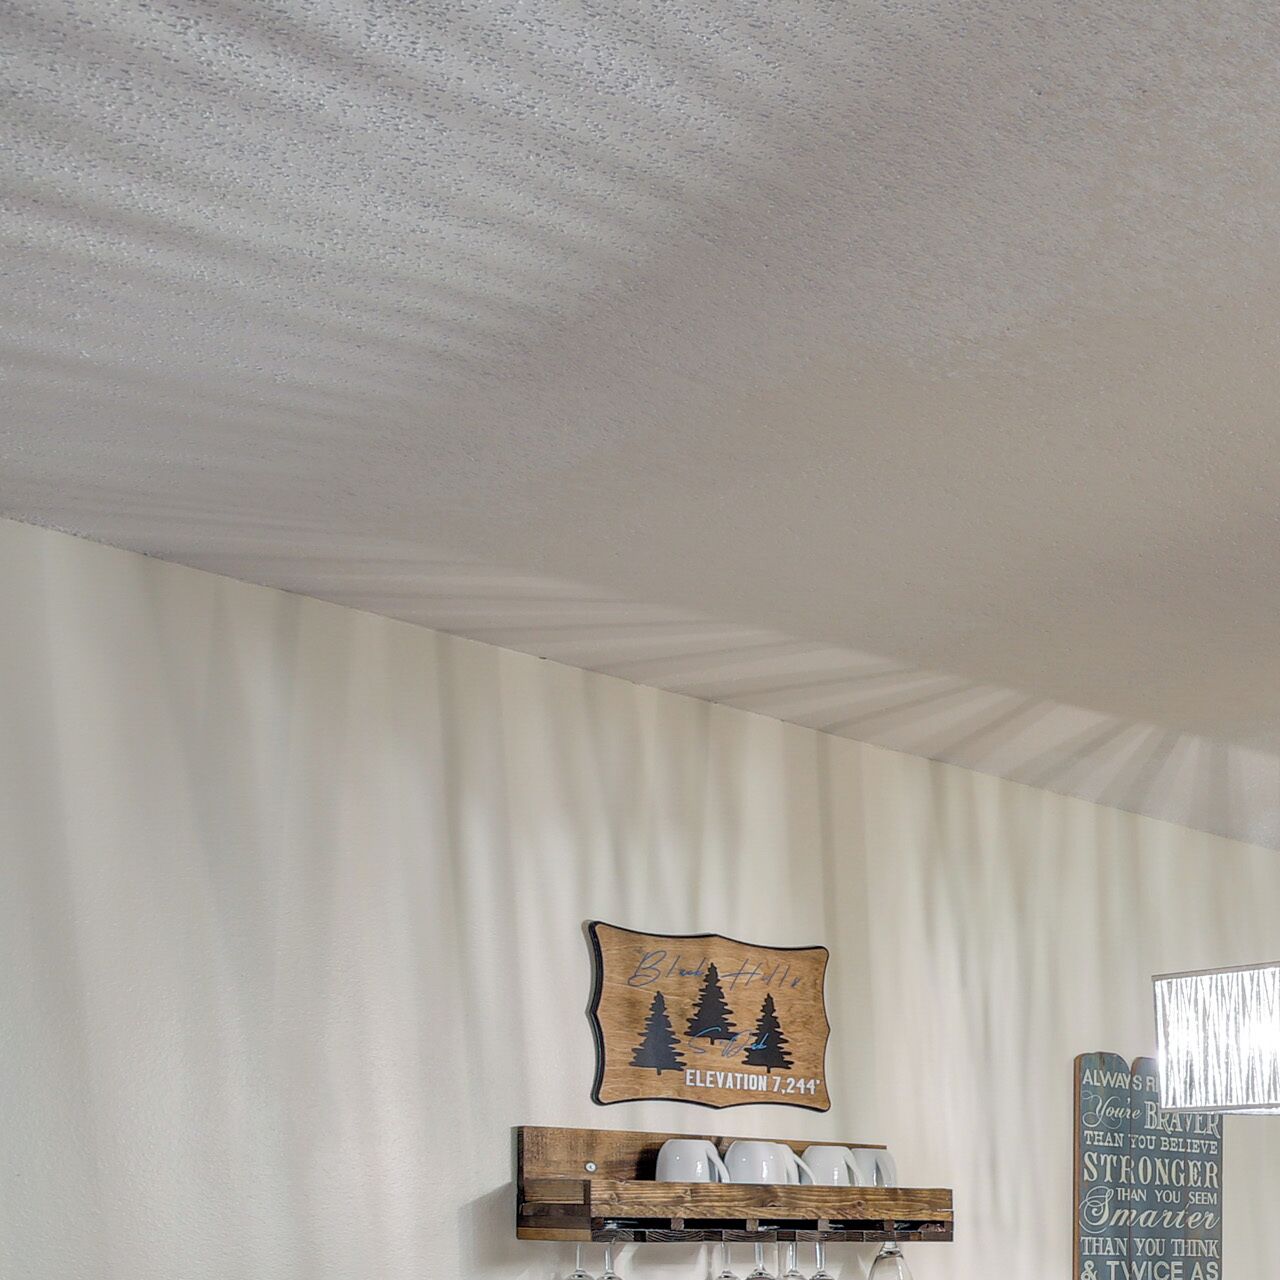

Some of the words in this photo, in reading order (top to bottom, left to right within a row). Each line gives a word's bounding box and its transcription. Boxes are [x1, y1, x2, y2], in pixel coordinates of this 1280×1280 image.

[628, 950, 706, 987] Black
[719, 958, 801, 991] Hills
[686, 1069, 767, 1091] ELEVATION
[772, 1076, 820, 1095] 7,244'
[1082, 1068, 1142, 1091] ALWAYS
[1082, 1090, 1142, 1130] You're
[1144, 1101, 1221, 1138] BRAVER
[1084, 1130, 1124, 1147] THAN
[1128, 1134, 1157, 1148] YOU
[1160, 1137, 1218, 1154] BELIEVE
[1083, 1151, 1219, 1189] STRONGER
[1079, 1185, 1220, 1234] Smarter
[1116, 1187, 1147, 1203] THAN
[1155, 1188, 1181, 1205] YOU
[1188, 1191, 1217, 1206] SEEM
[1081, 1236, 1128, 1256] THAN
[1134, 1237, 1166, 1257] YOU
[1171, 1238, 1220, 1259] THINK
